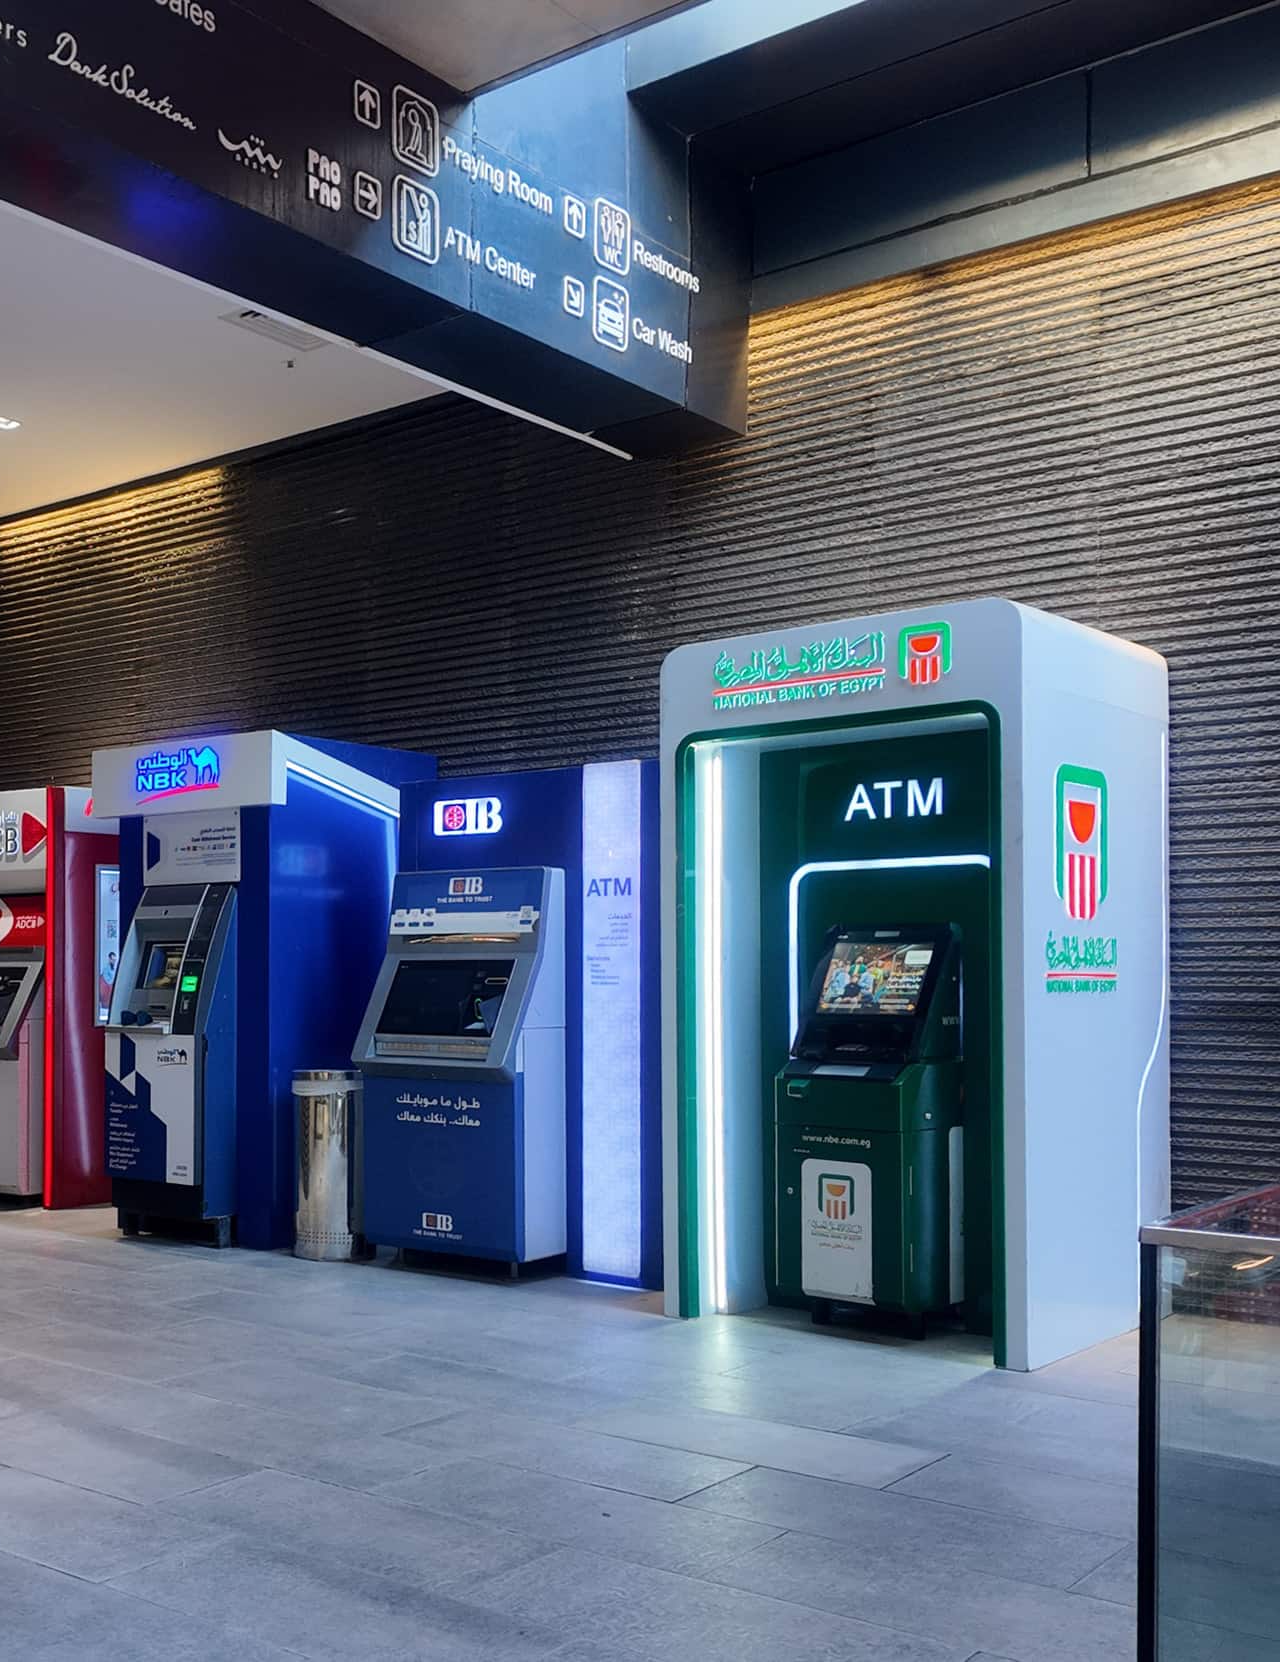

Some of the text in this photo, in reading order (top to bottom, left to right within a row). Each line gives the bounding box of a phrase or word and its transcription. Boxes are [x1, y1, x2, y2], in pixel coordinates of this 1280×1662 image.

[308, 147, 341, 186] PAO
[443, 136, 553, 215] Praying Room
[308, 174, 341, 212] PAO
[444, 226, 537, 289] ATM Center
[633, 239, 700, 293] Restrooms
[632, 317, 693, 364] Car Wash
[713, 674, 887, 711] NATIONAL BANK OF EGYPT
[138, 748, 188, 774] الوطني
[137, 770, 187, 792] NBK
[844, 777, 944, 823] ATM
[586, 877, 632, 897] ATM
[802, 1135, 871, 1149] www.nbe.com.eg
